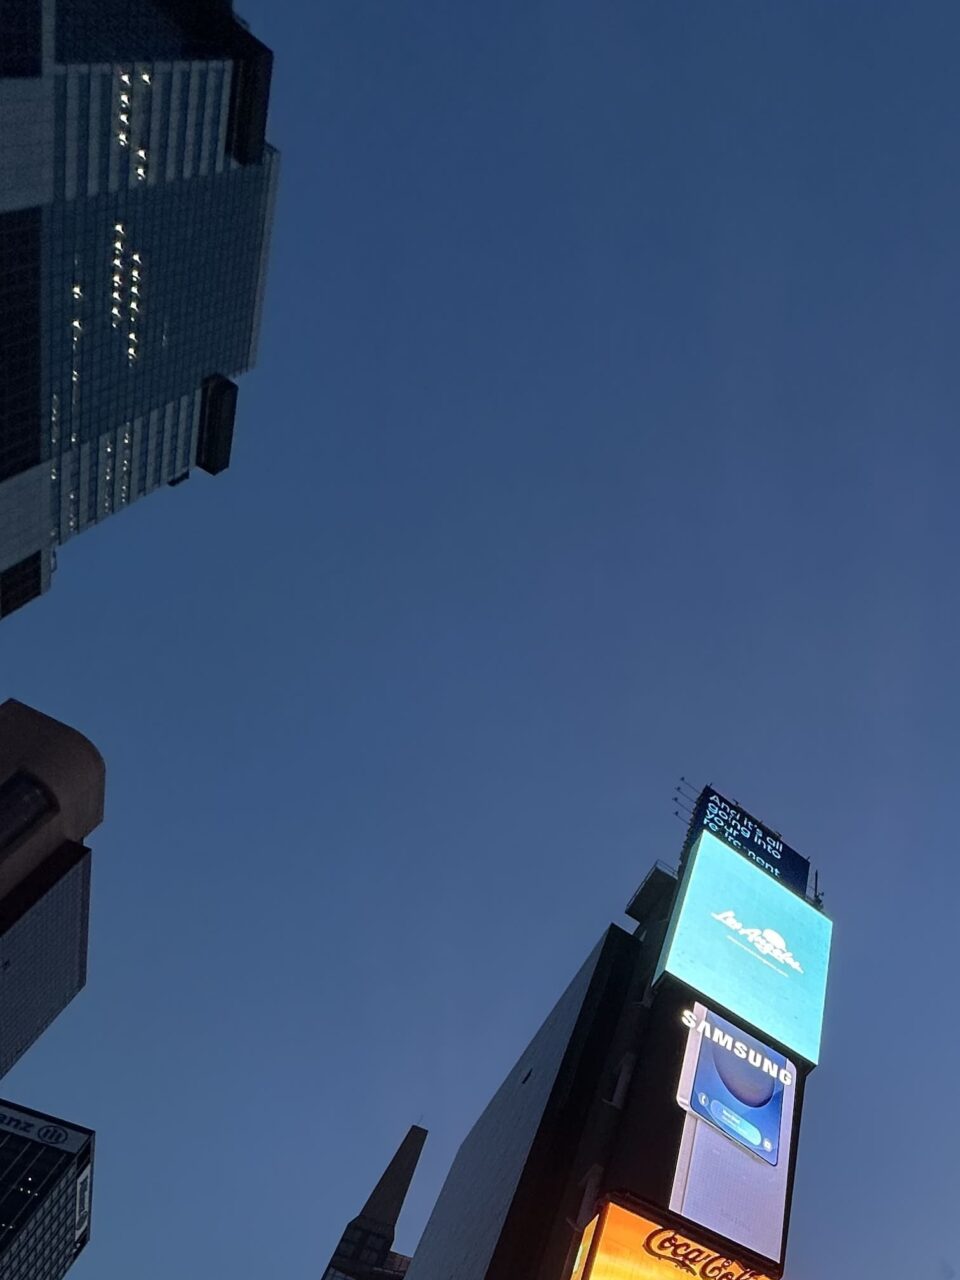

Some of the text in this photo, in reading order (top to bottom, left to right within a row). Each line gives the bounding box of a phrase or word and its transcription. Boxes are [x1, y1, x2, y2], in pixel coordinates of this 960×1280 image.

[707, 802, 782, 860] going into
[766, 835, 784, 852] all
[682, 1008, 792, 1085] SAMSUNG
